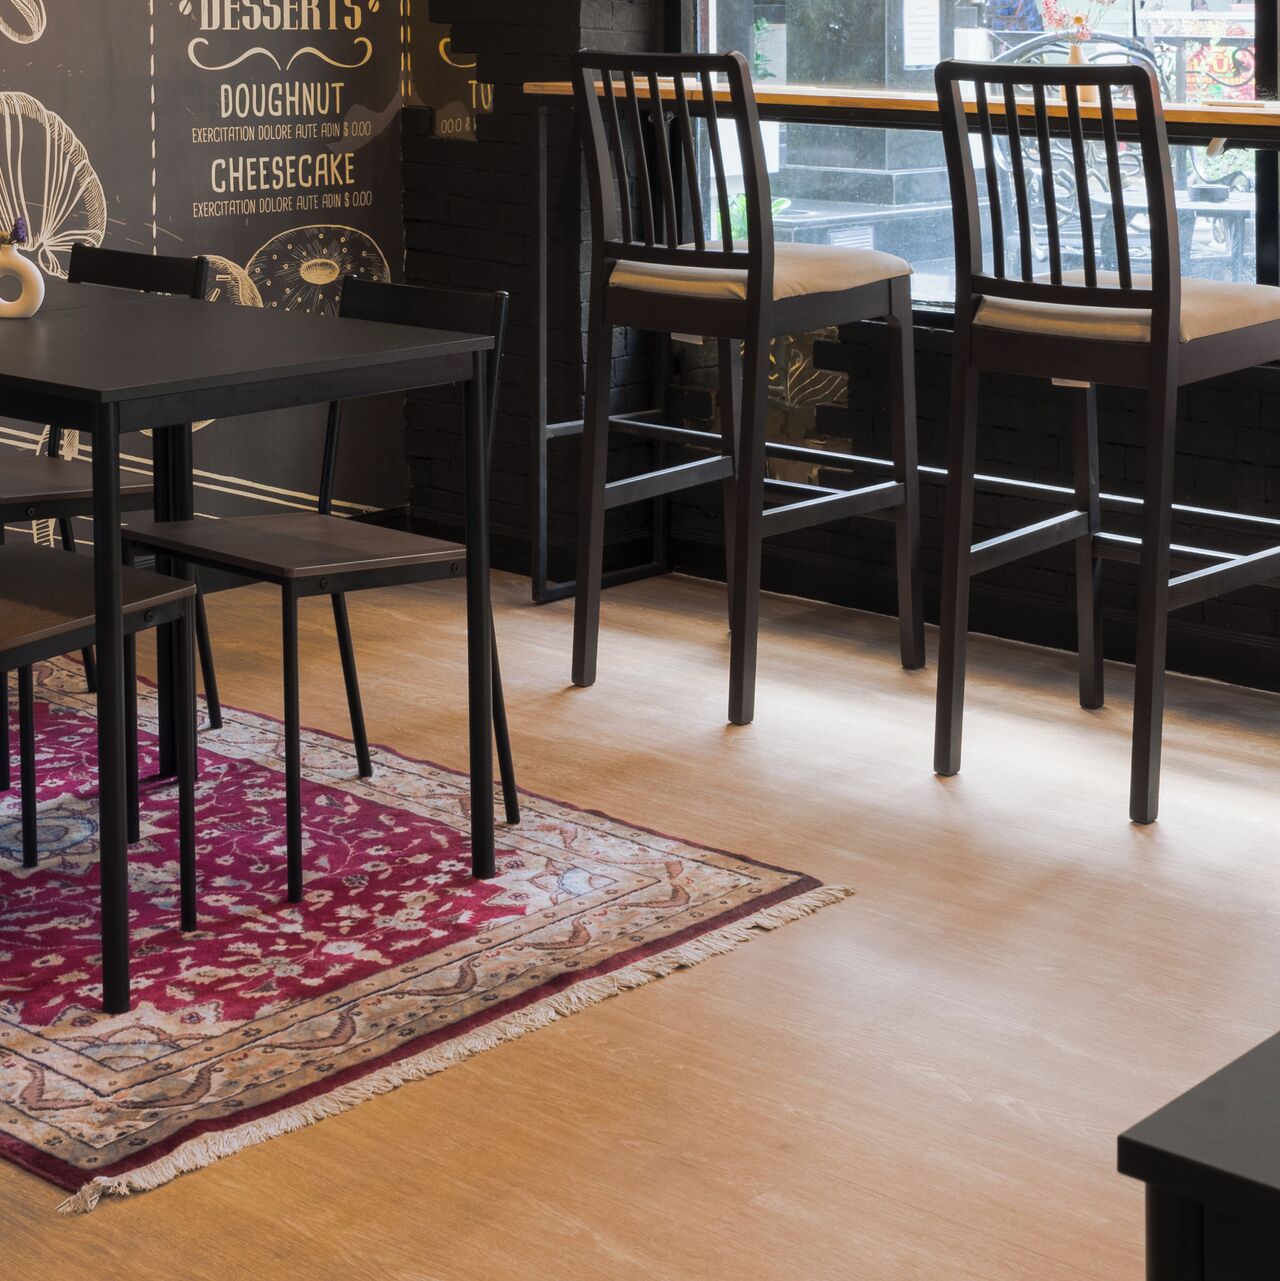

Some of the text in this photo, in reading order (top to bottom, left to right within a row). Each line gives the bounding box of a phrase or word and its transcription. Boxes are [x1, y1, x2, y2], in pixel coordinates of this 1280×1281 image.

[220, 81, 344, 118] DOUGHNUT
[192, 121, 371, 143] EXERCITATION DOLORE AUTE ADIN $ 0.00
[212, 153, 355, 193] CHEESECAKE
[193, 191, 372, 217] EXERCITATION DOLORE AUTE ADIN $ 0.00
